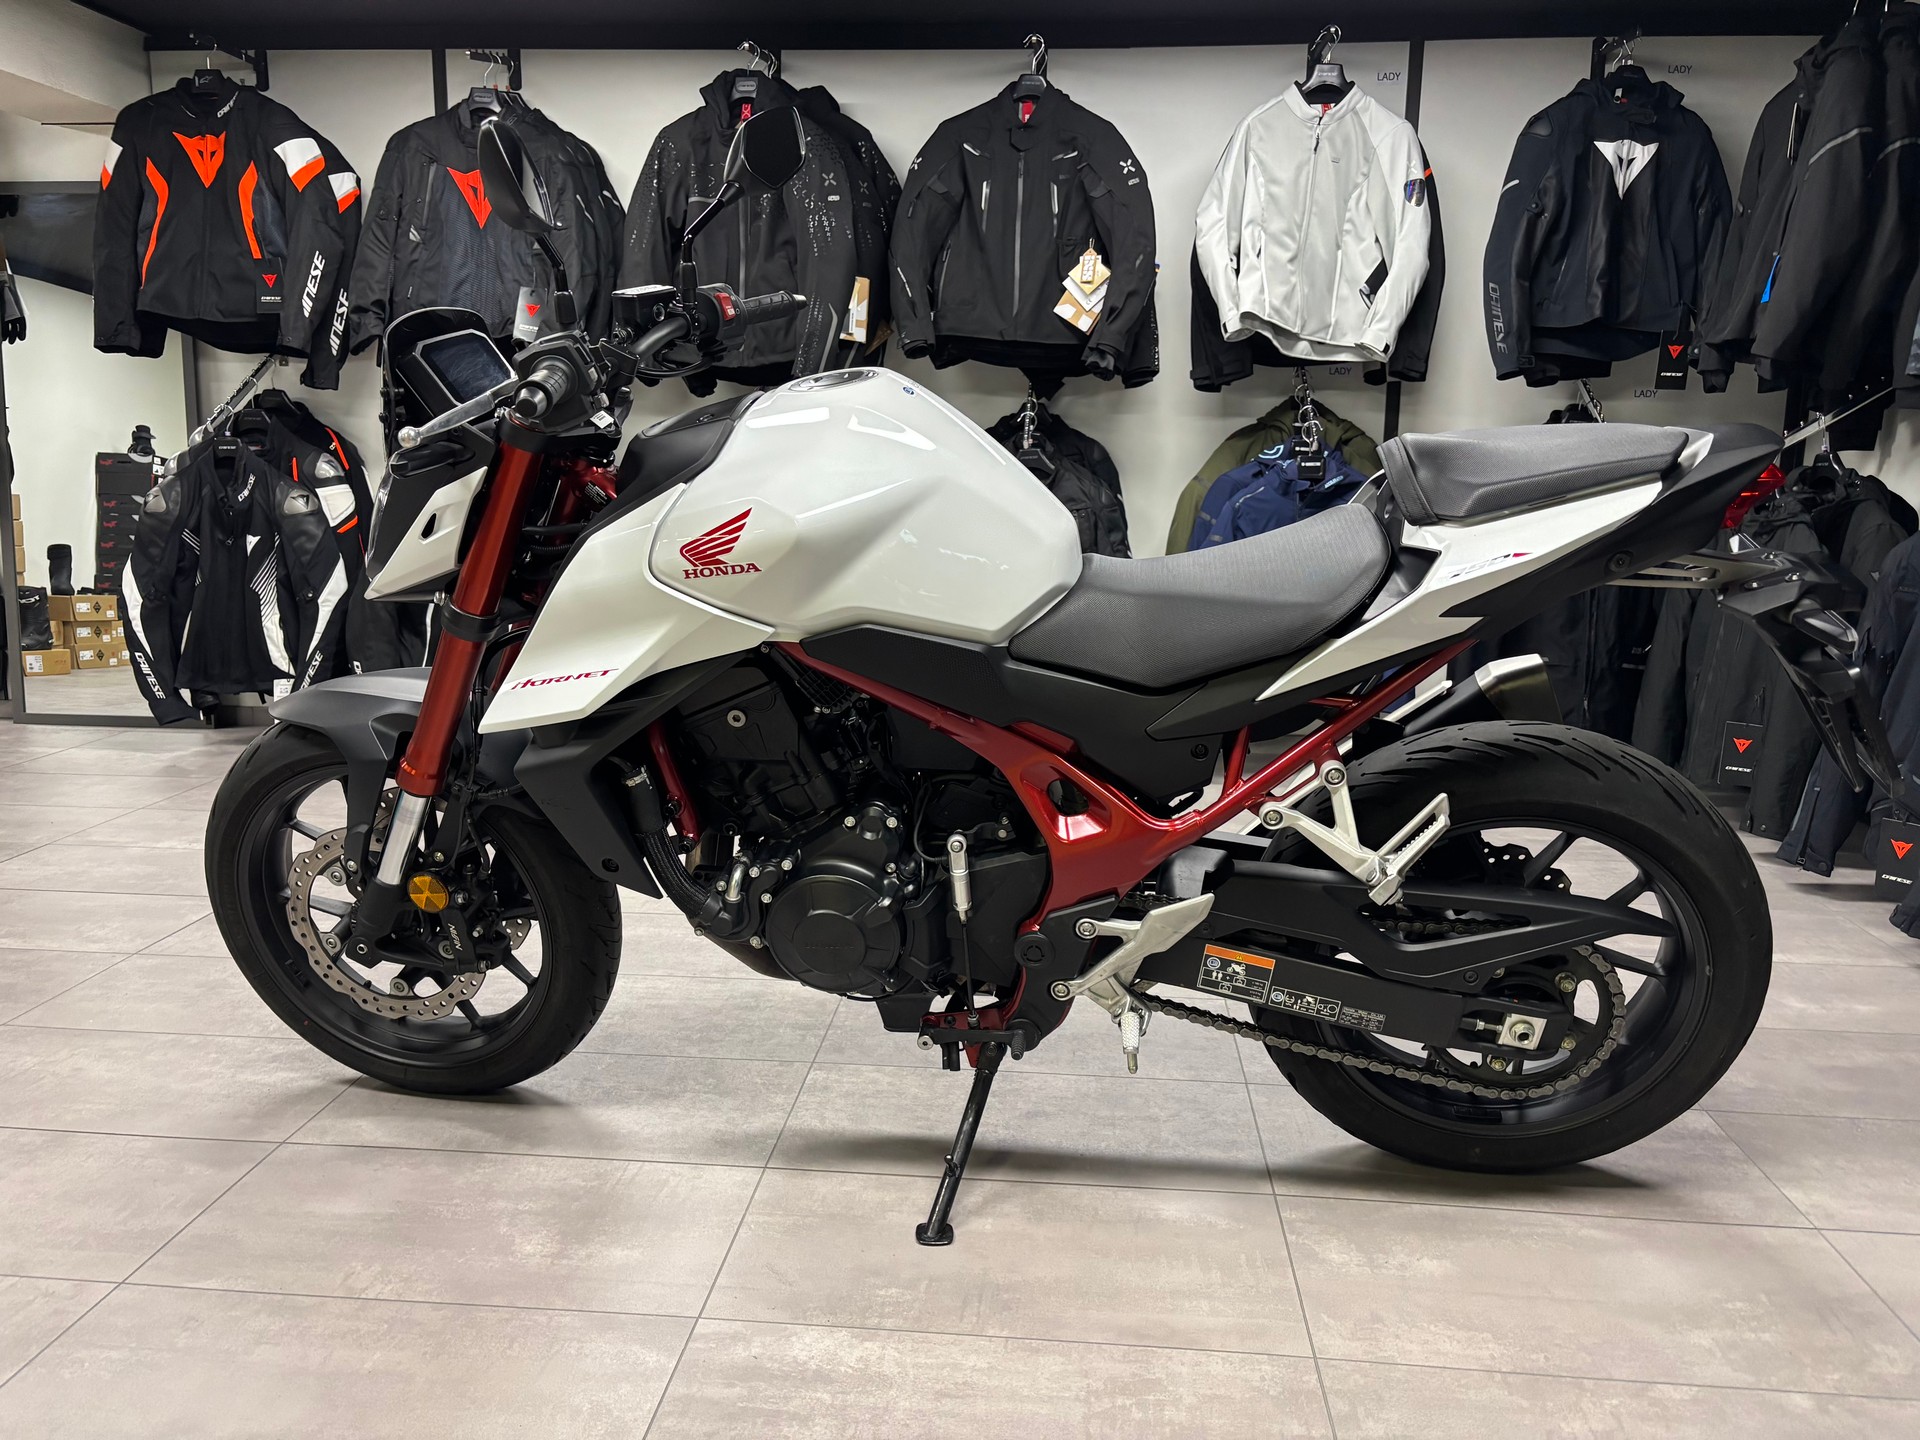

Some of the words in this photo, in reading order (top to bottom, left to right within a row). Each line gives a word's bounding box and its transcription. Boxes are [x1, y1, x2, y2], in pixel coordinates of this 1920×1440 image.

[1667, 65, 1693, 74] LADY
[1377, 72, 1401, 81] LADY
[1328, 367, 1352, 376] LADY
[1634, 390, 1658, 398] LADY
[682, 562, 763, 579] HONDA
[134, 652, 166, 699] DAINESE
[300, 650, 324, 690] AINESE
[510, 668, 620, 690] HORNET
